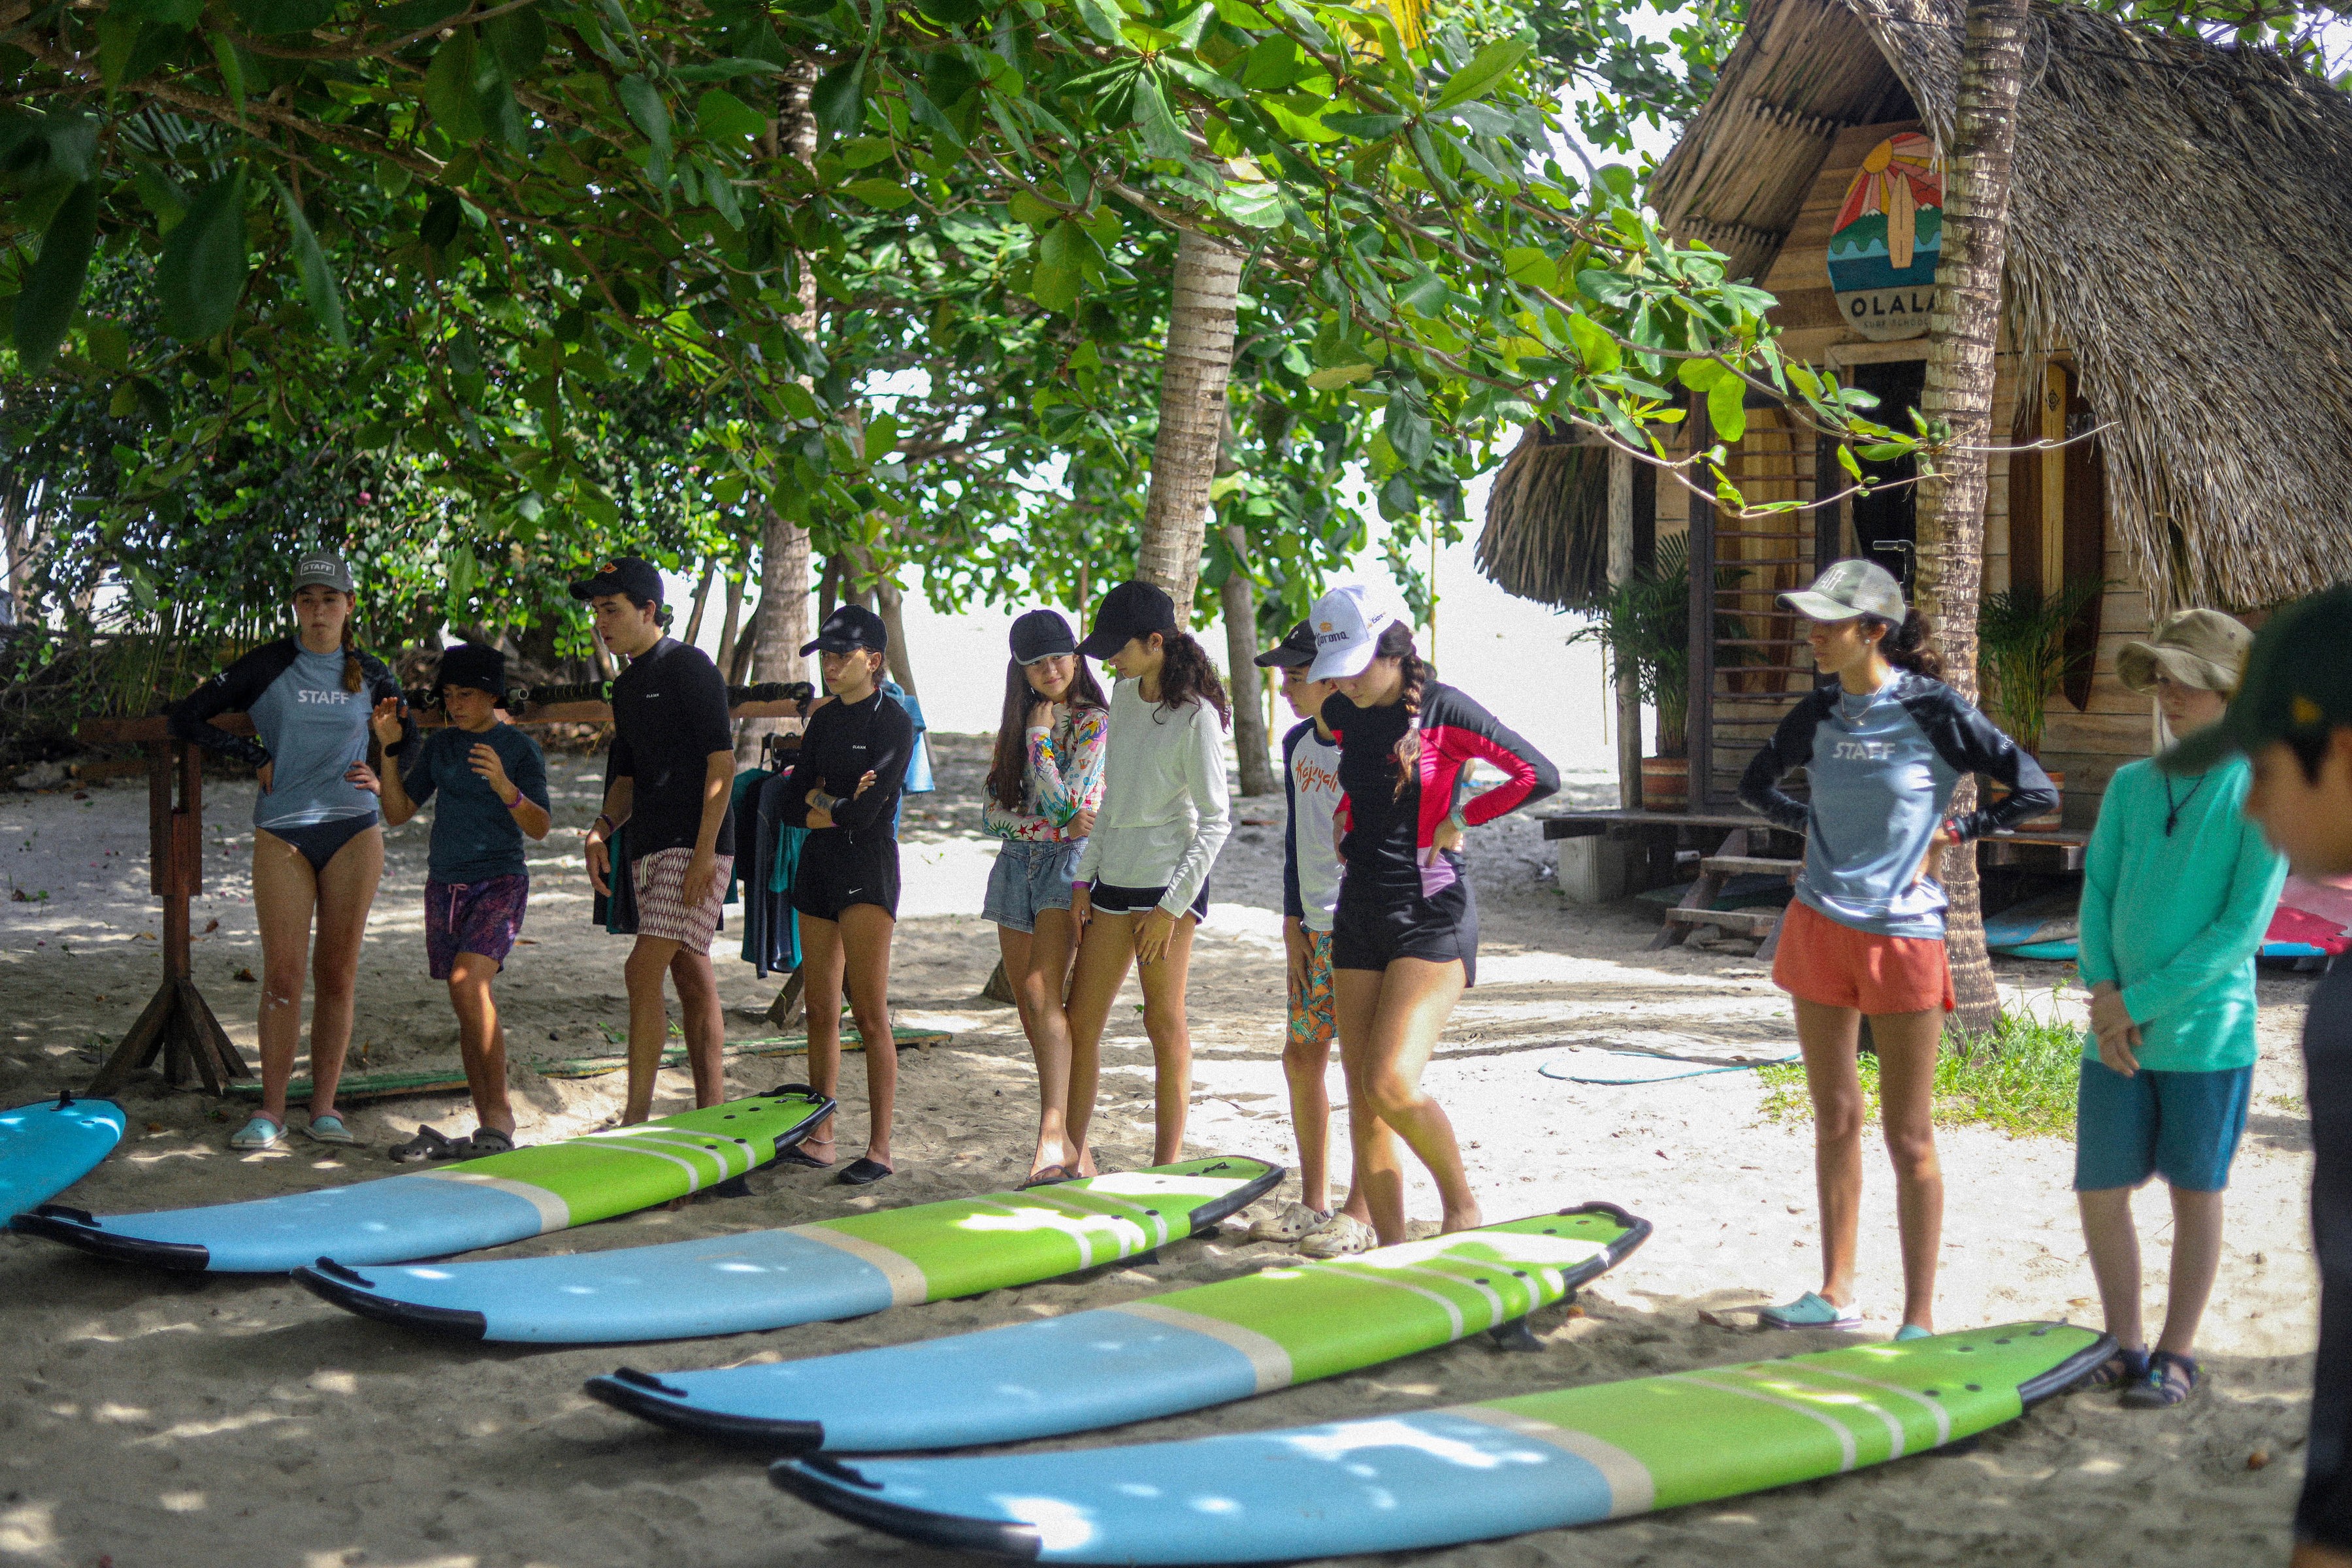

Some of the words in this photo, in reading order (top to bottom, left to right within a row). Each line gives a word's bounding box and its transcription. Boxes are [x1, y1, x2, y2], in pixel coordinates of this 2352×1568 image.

[1864, 319, 1885, 328] SURF
[1820, 568, 1847, 591] AFF
[1315, 631, 1349, 647] Corona
[298, 690, 349, 704] STAFF
[1832, 742, 1895, 760] STAFF
